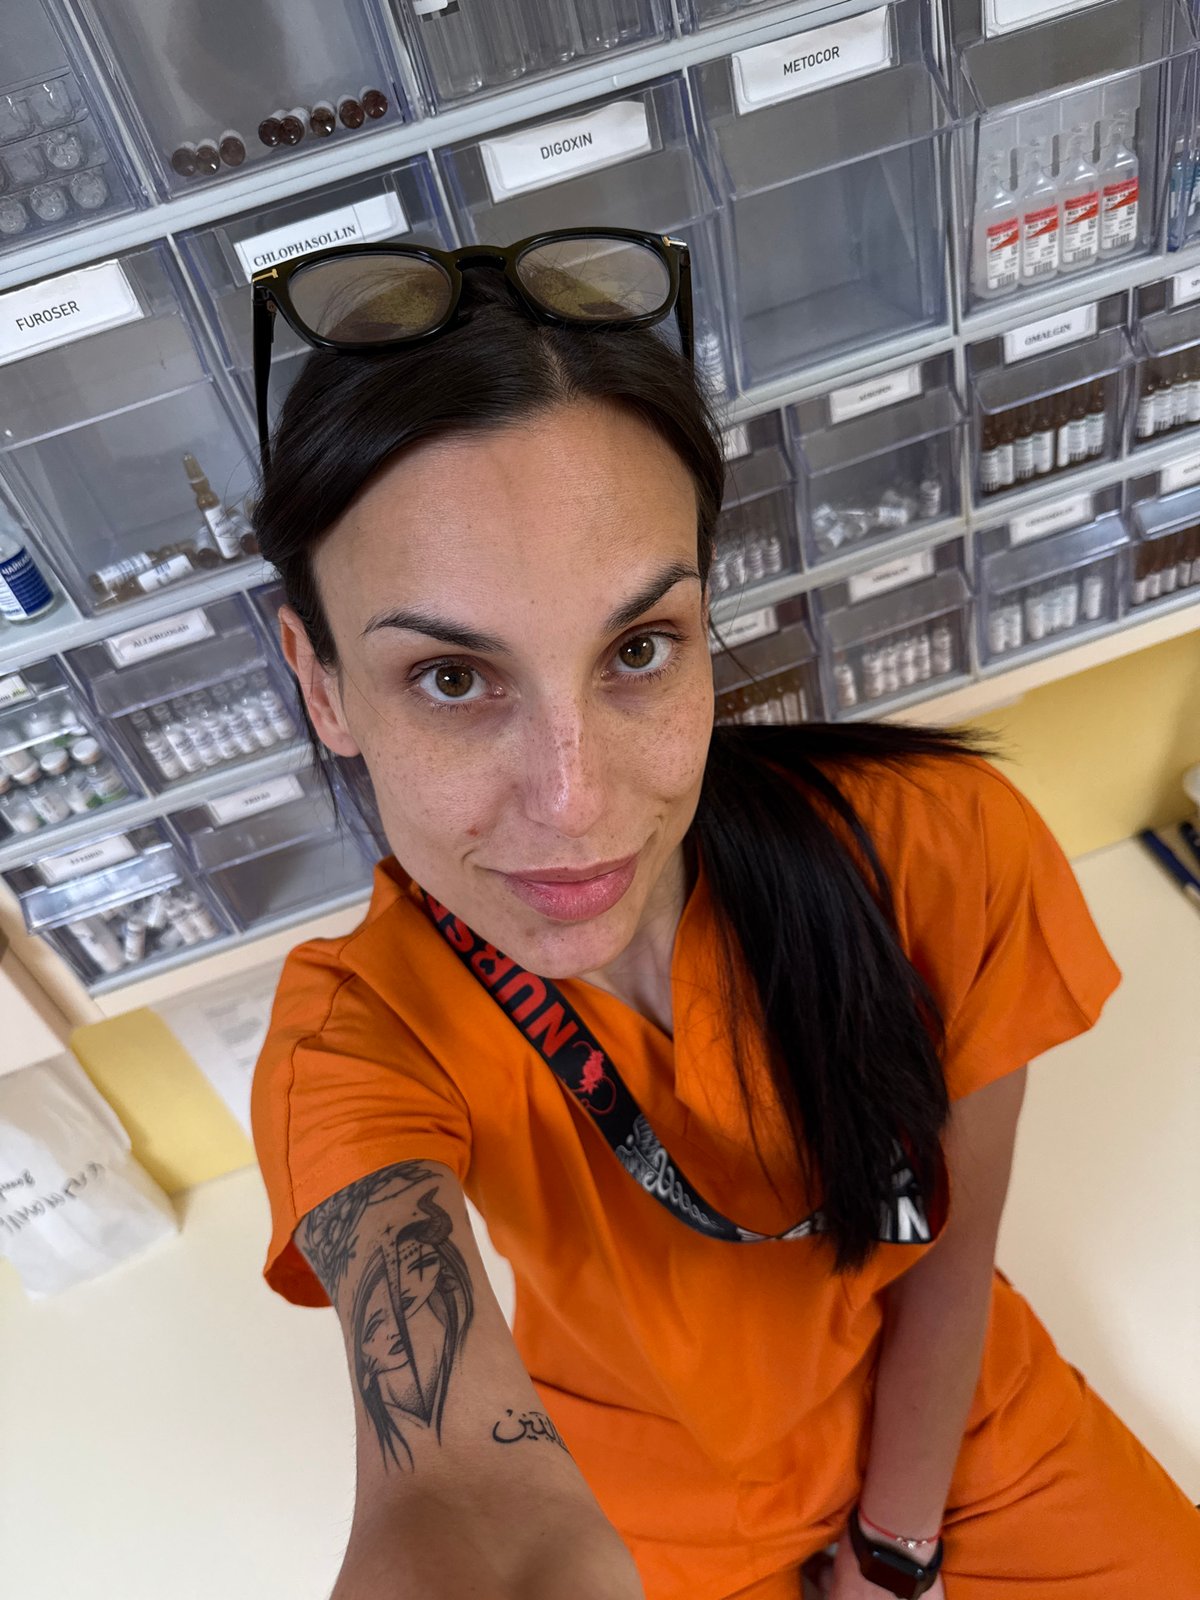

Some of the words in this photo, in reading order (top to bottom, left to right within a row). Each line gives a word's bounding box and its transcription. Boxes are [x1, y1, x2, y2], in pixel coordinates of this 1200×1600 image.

[783, 46, 840, 76] METOCOR
[540, 132, 593, 160] DIGOXIN
[253, 225, 357, 268] CHLOPHASOLLIN
[15, 300, 80, 331] FUROSER
